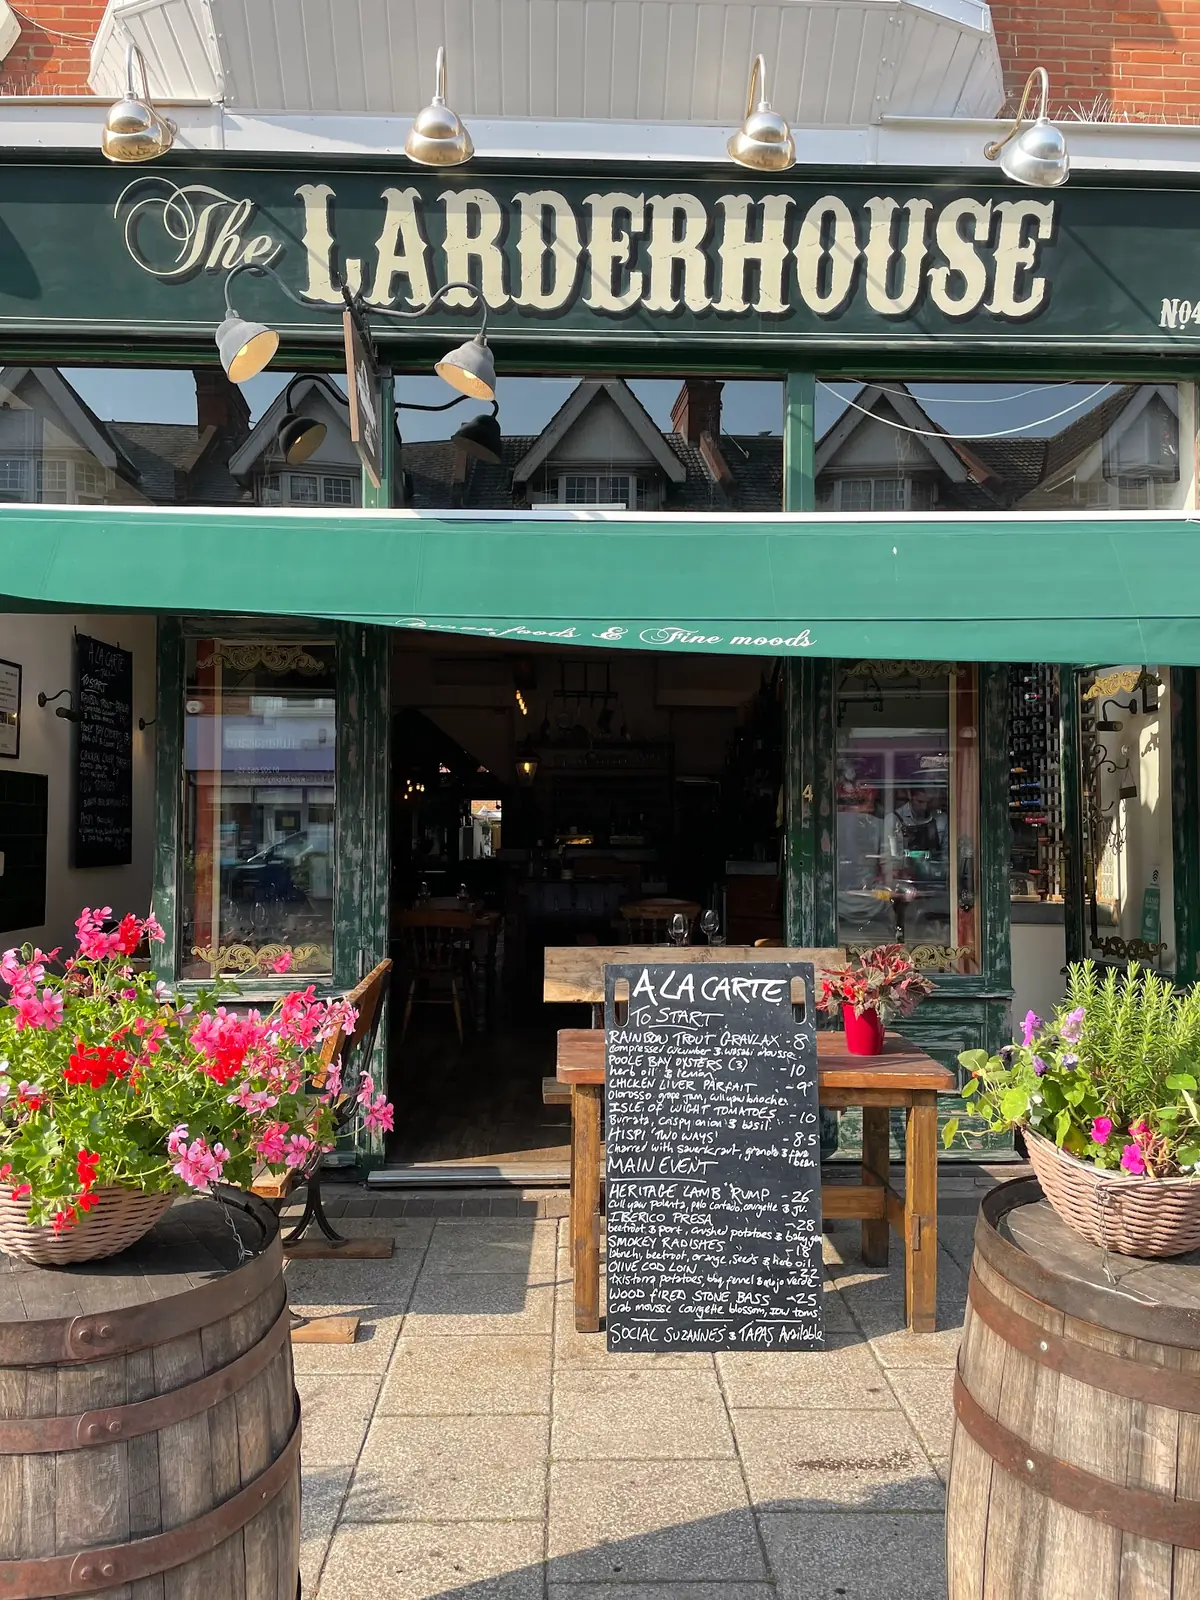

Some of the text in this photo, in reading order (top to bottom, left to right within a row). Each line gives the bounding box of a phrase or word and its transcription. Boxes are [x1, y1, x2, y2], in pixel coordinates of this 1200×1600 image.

[114, 176, 1056, 317] The LARDERHOUSE
[639, 626, 723, 647] Fine
[728, 628, 818, 649] moods
[802, 784, 814, 803] 4
[632, 968, 788, 1006] A LA CARTE
[655, 1007, 724, 1028] START
[609, 1031, 668, 1044] RAINBOW
[672, 1031, 716, 1046] TROUT
[720, 1031, 780, 1047] GRAVLAX
[667, 1046, 711, 1055] cucumber
[725, 1048, 754, 1056] wasabi
[609, 1055, 644, 1066] POOLE
[648, 1056, 671, 1070] BAY
[676, 1056, 722, 1071] OYSTERS
[728, 1057, 748, 1072] (3)
[610, 1065, 635, 1076] herb
[641, 1068, 654, 1076] oil
[610, 1077, 656, 1088] CHICKEN
[659, 1080, 696, 1090] LIVER
[656, 1092, 679, 1103] grape
[609, 1101, 644, 1113] ISLE
[670, 1104, 711, 1115] WIGHT
[714, 1107, 777, 1118] TOMATOES
[695, 1118, 721, 1127] onion
[608, 1127, 645, 1142] HISPI
[651, 1142, 673, 1153] with
[608, 1156, 718, 1175] MAIN EVENT
[609, 1184, 678, 1199] HERITAGE
[683, 1185, 720, 1200] LAMB
[730, 1187, 769, 1204] RUMP
[609, 1211, 665, 1222] IBERICO
[673, 1213, 713, 1226] PRESA
[730, 1228, 772, 1241] potatoes
[608, 1236, 657, 1249] SMOKEY
[662, 1237, 726, 1252] RADISHES
[641, 1262, 665, 1271] COD
[669, 1262, 697, 1273] LOIN
[610, 1288, 645, 1299] WOOD
[692, 1290, 731, 1302] STONE
[736, 1291, 769, 1305] BASS
[635, 1304, 671, 1313] mousse
[610, 1323, 658, 1343] SOCIAL
[738, 1321, 774, 1344] TAPAS
